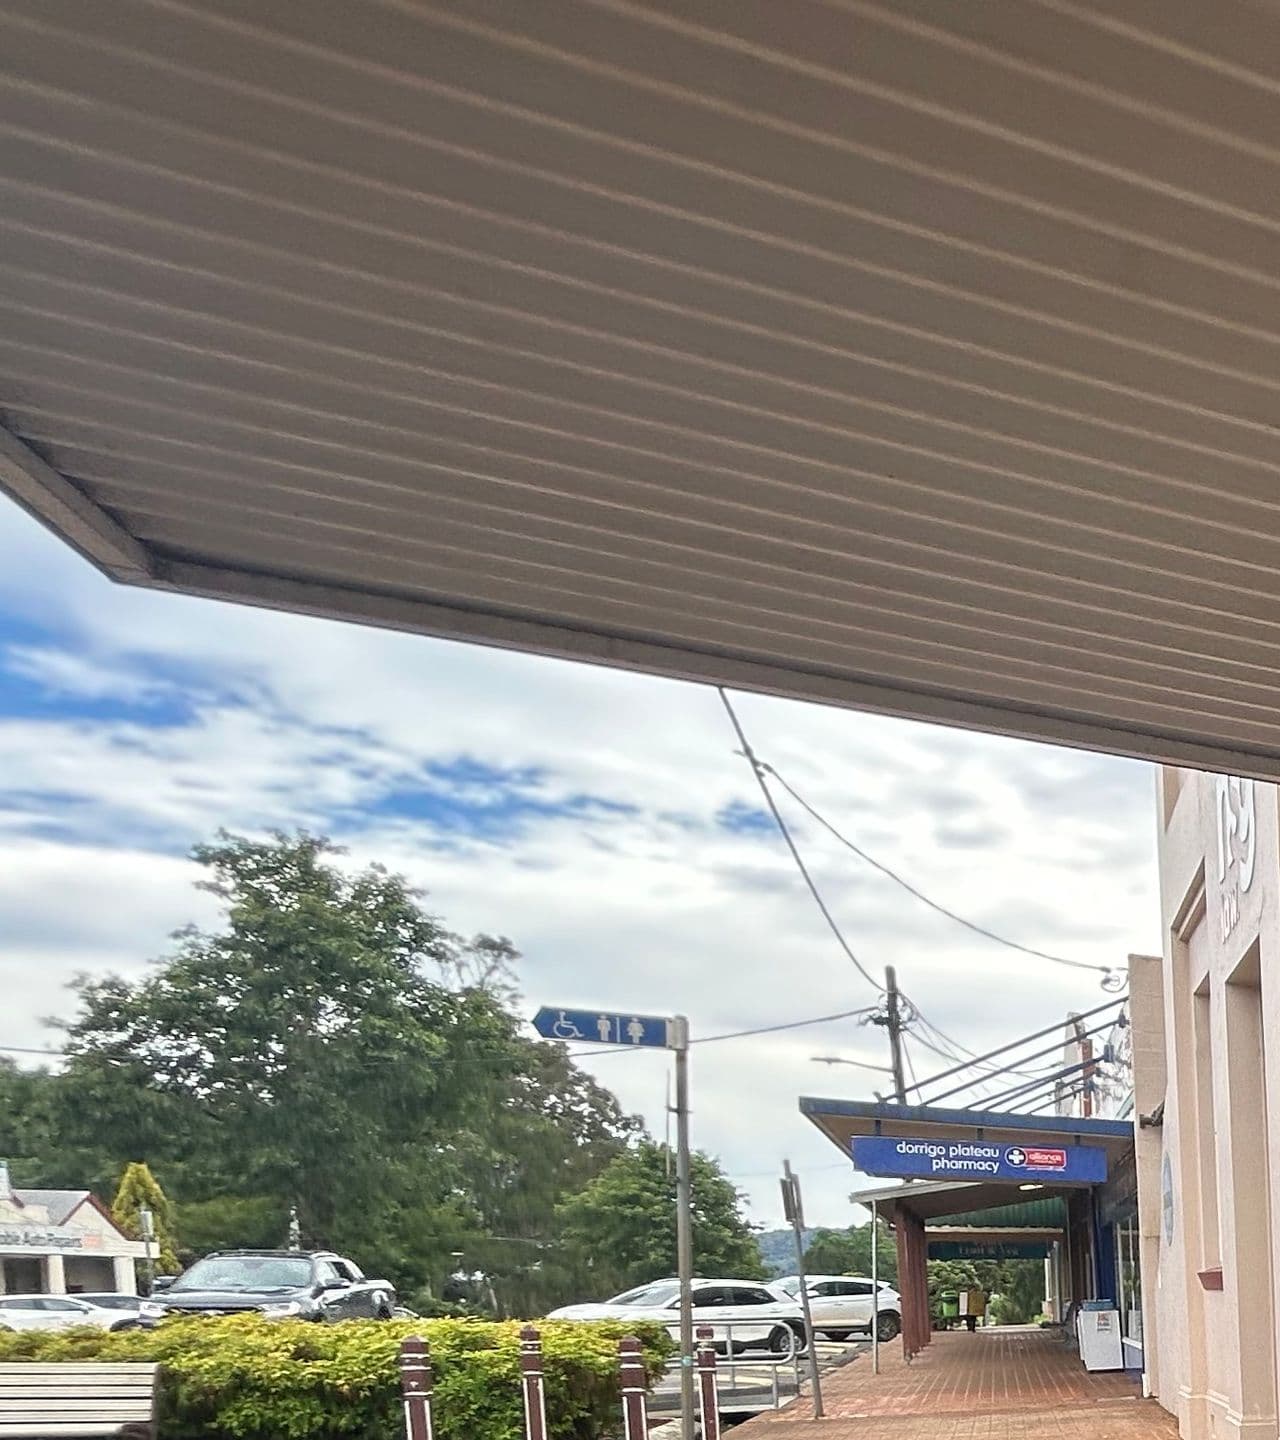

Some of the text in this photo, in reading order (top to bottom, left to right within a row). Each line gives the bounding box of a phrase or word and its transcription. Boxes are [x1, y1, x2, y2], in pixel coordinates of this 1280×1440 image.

[896, 1140, 999, 1158] dorrigo plateau
[932, 1156, 999, 1173] pharmacy
